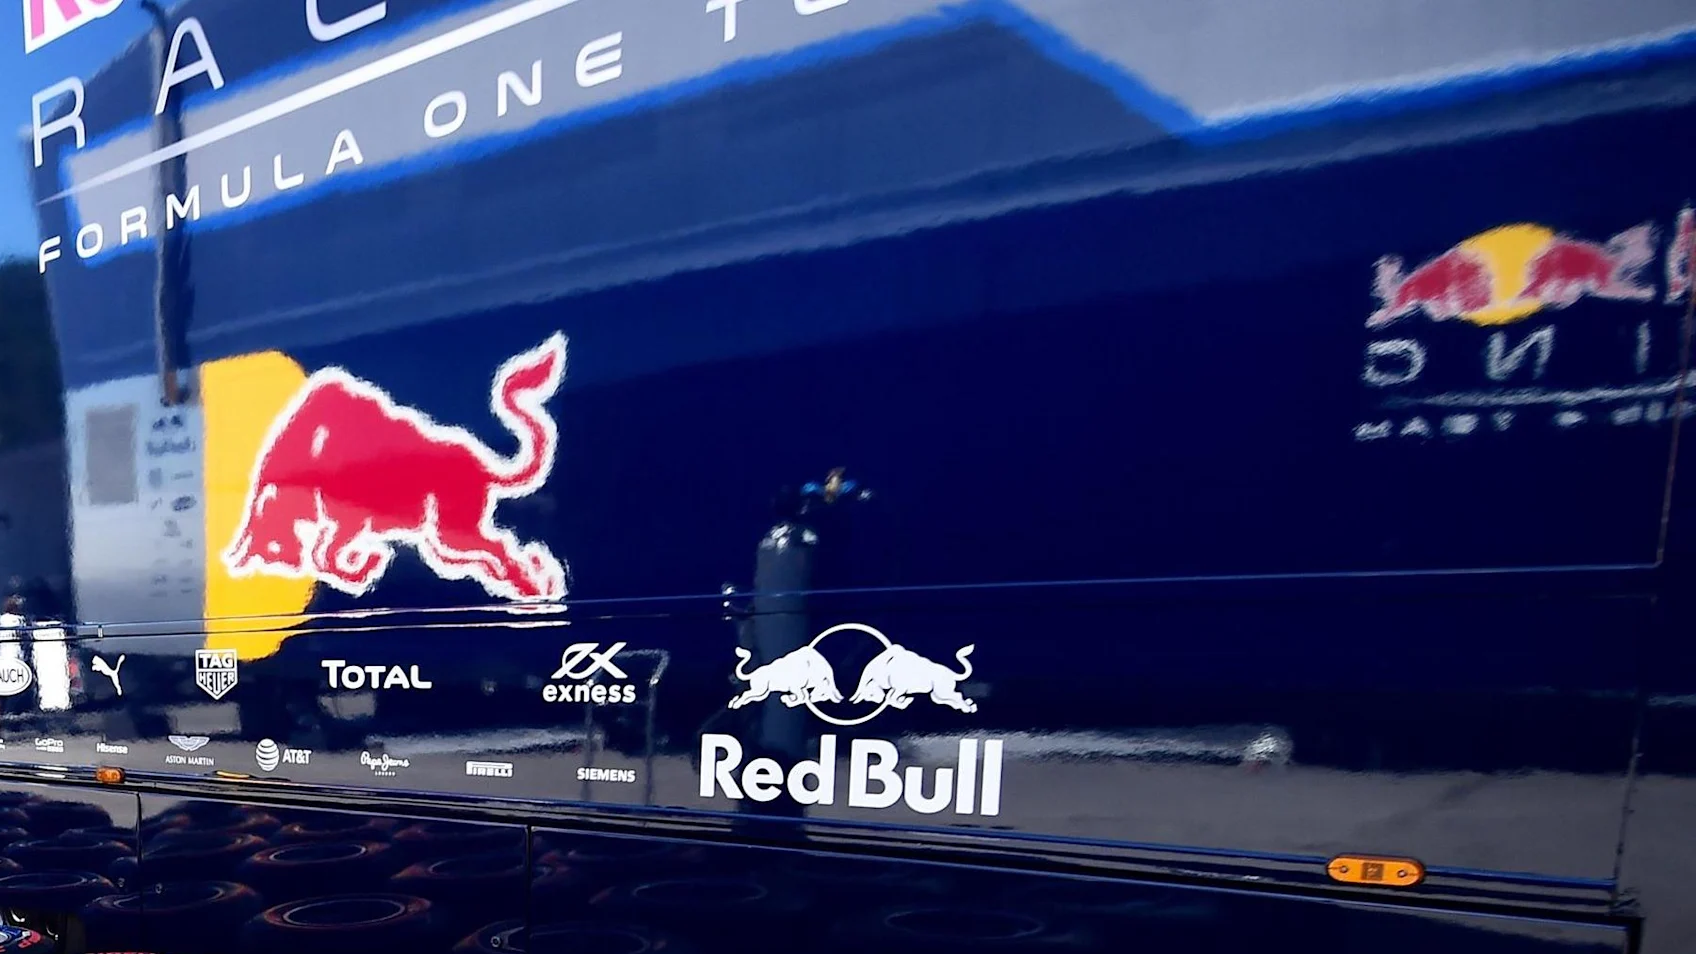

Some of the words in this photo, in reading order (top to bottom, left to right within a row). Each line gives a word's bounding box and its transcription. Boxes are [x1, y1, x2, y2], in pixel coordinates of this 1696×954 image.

[39, 130, 364, 274] FORMULA
[421, 31, 624, 138] ONE
[199, 653, 234, 668] TAG
[199, 672, 235, 692] HEUER
[321, 660, 432, 689] TOTAL
[543, 681, 636, 704] exness
[35, 738, 63, 746] GoPro
[96, 743, 128, 754] Hisense
[165, 755, 186, 765] ASTON
[188, 756, 214, 766] MARTIN
[282, 750, 311, 764] AT&T
[466, 761, 513, 777] PIRELLI
[577, 766, 636, 783] SIEMENS
